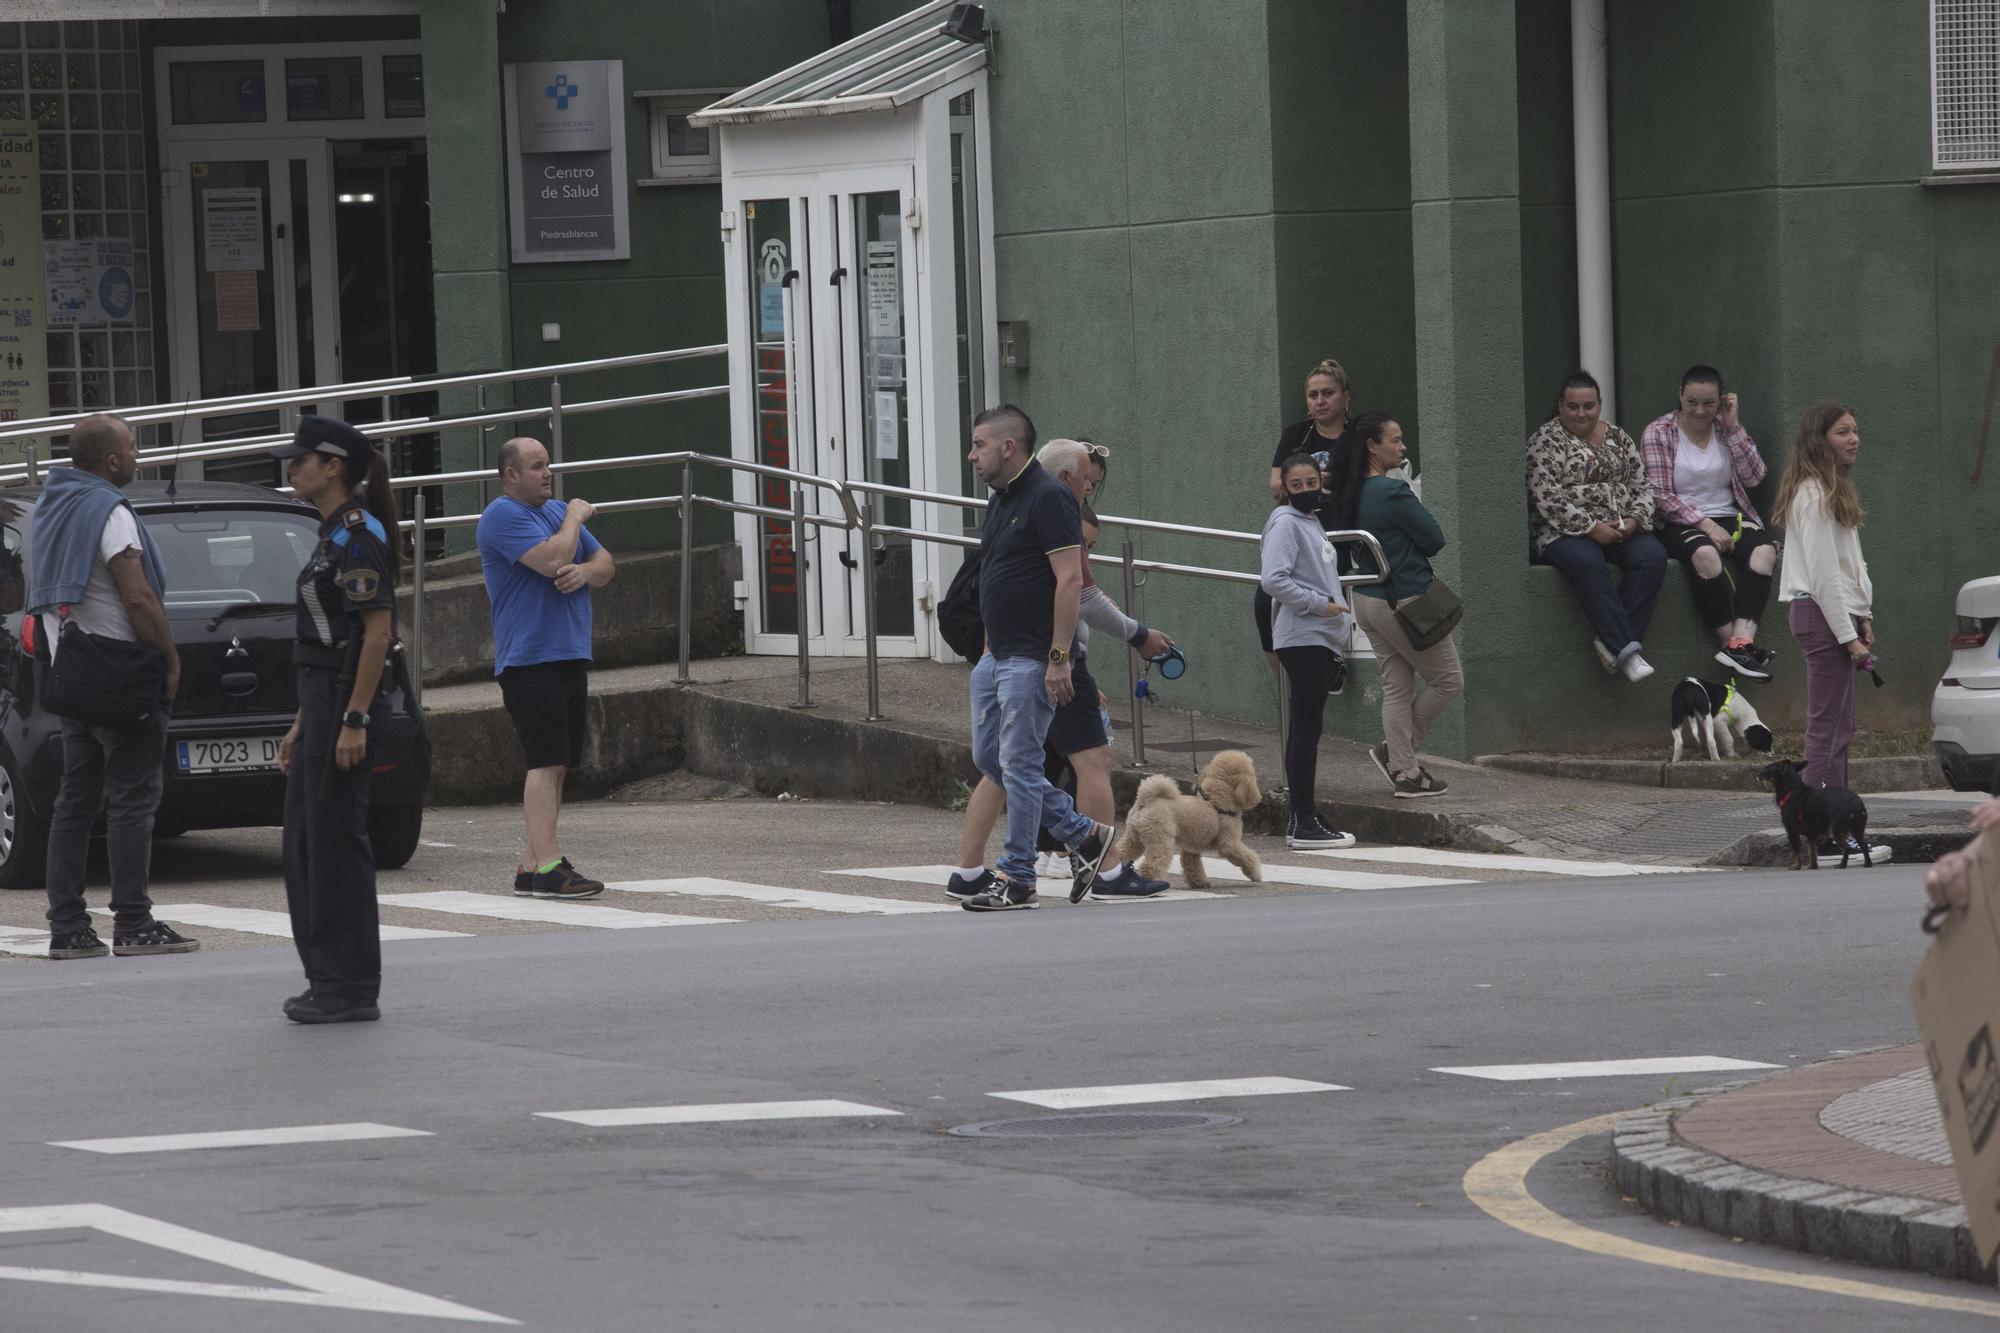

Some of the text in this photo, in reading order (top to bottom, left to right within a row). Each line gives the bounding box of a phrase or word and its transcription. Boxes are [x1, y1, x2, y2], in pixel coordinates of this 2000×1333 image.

[544, 166, 594, 180] Centro
[541, 184, 599, 199] de Salud
[540, 229, 598, 240] Piedrasblancas
[195, 741, 249, 765] 7023
